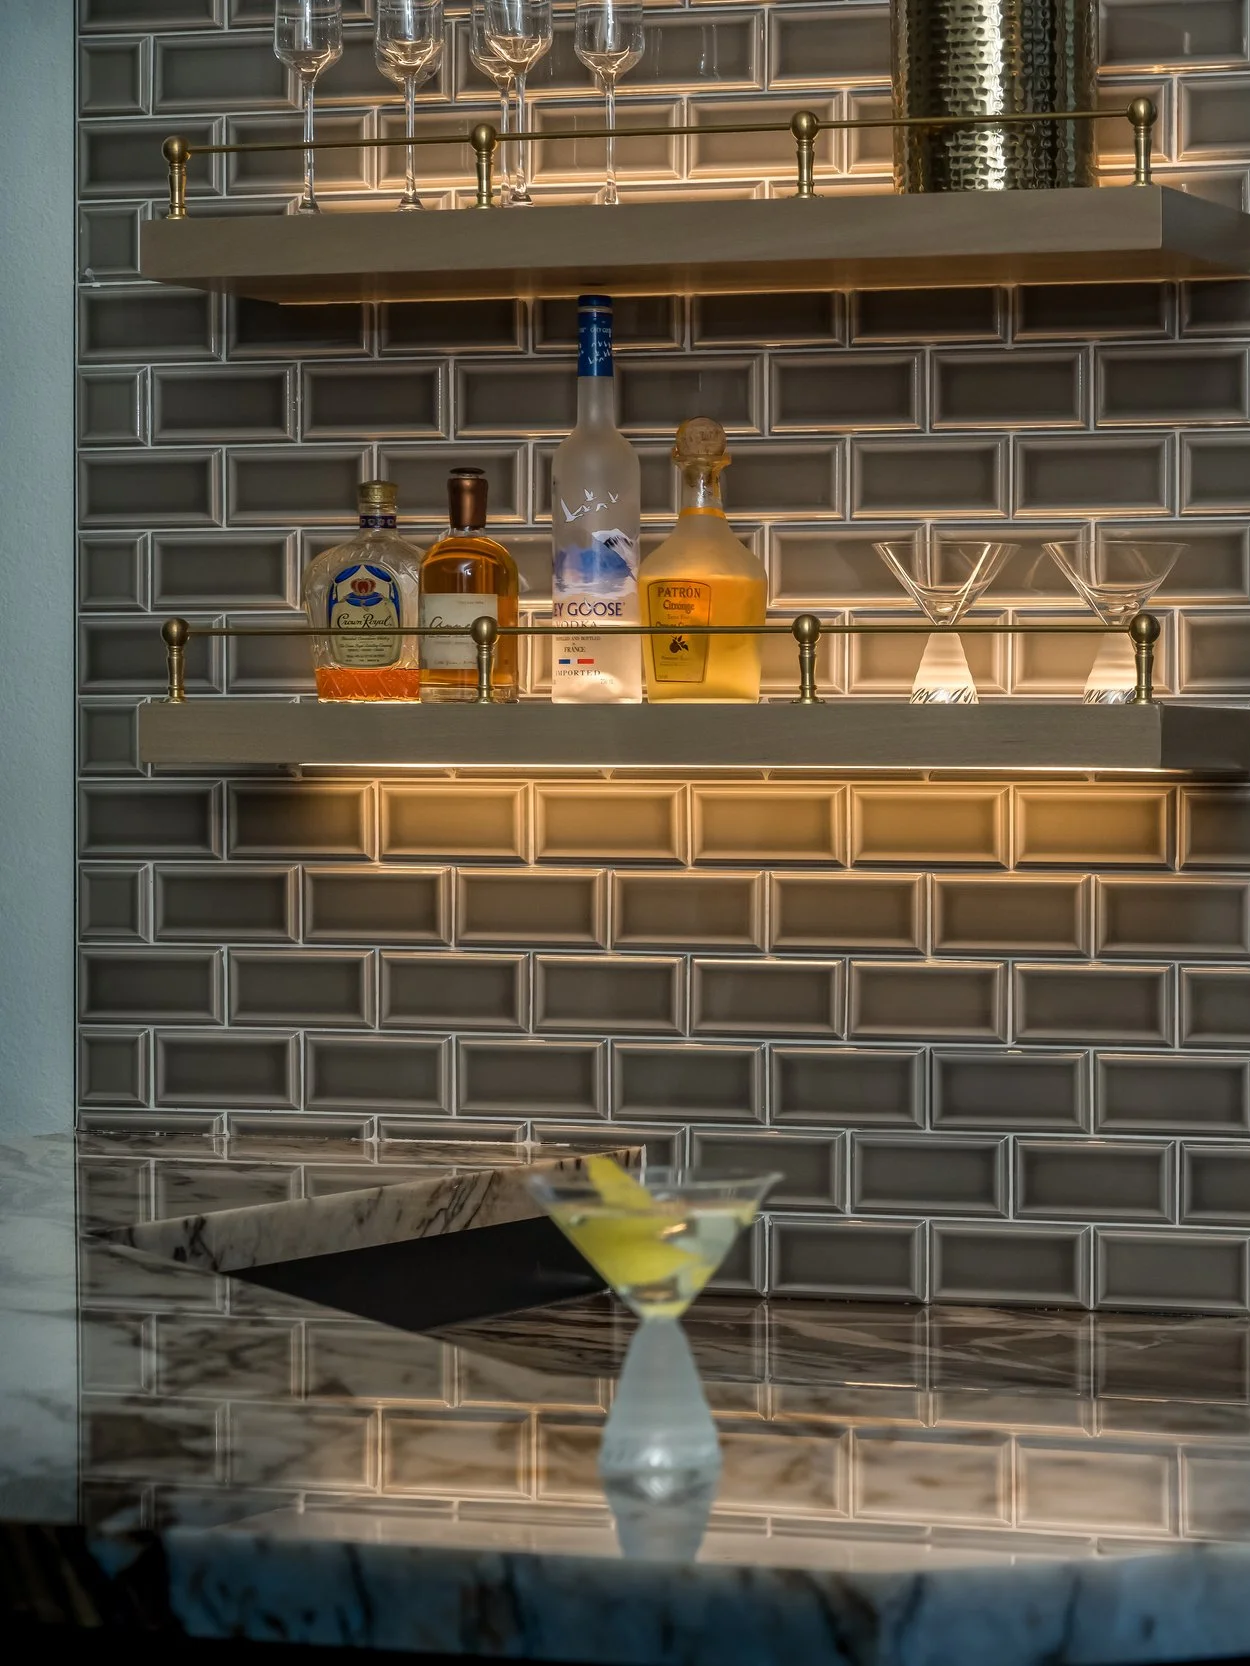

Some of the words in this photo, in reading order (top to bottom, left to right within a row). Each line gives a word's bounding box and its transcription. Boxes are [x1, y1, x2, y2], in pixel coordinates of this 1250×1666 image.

[657, 585, 701, 599] PATRÓN
[567, 601, 623, 617] GOOSE
[337, 613, 363, 629] Crown
[362, 613, 391, 629] Royal
[555, 620, 597, 628] VODKA
[555, 669, 601, 677] IMPORTED
